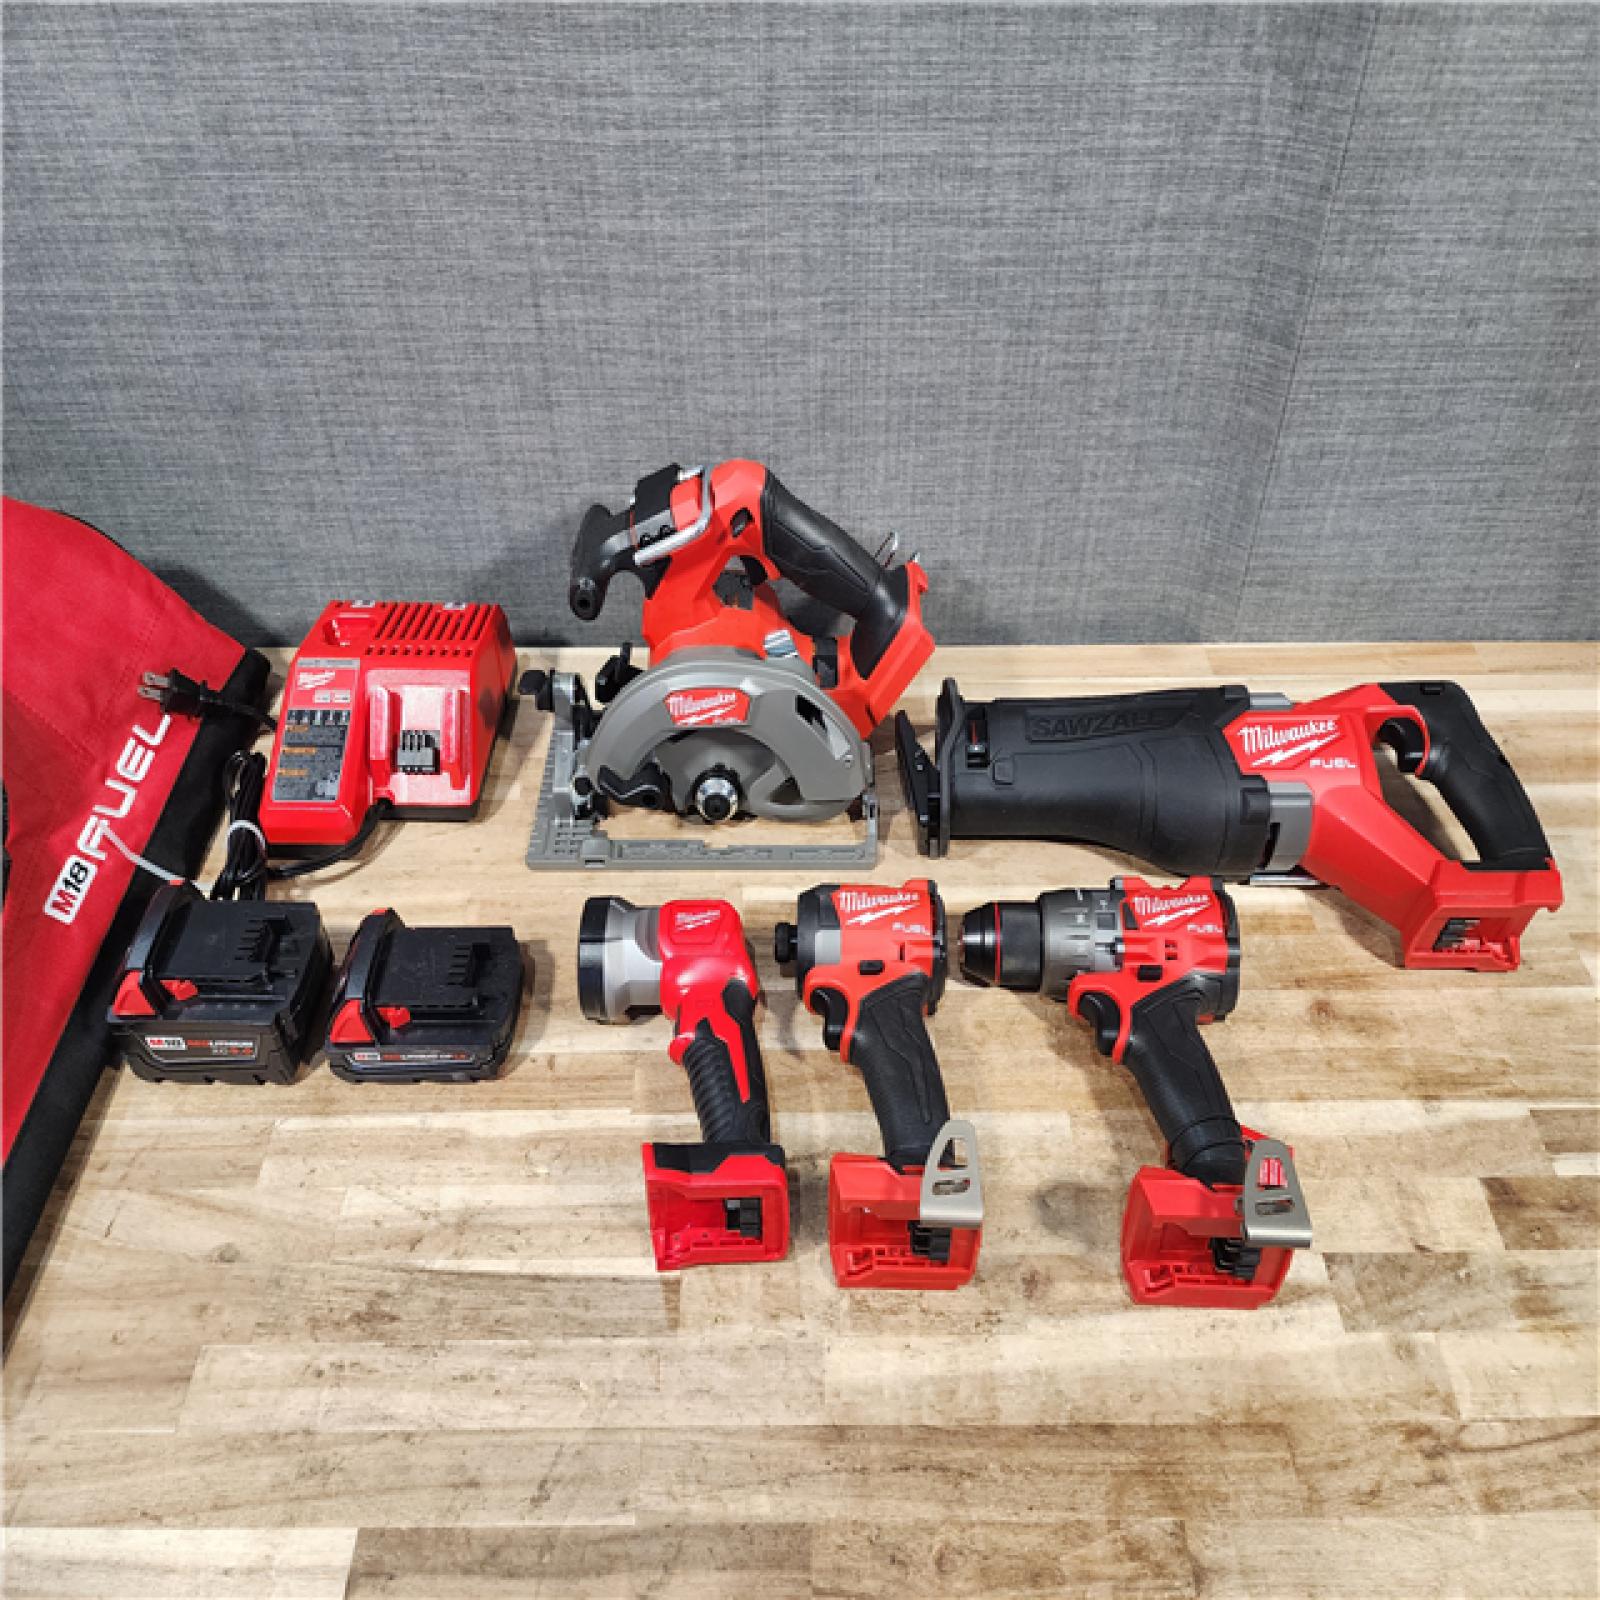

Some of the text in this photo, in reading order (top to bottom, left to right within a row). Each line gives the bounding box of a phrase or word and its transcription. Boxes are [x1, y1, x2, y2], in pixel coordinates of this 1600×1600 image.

[1238, 718, 1339, 755] Milwaukee
[1309, 757, 1358, 769] FUEL
[51, 714, 171, 916] M18 FUEL
[838, 890, 919, 913] Milwaukee
[1133, 894, 1210, 916] Milwaukee
[1186, 923, 1223, 934] FUEL
